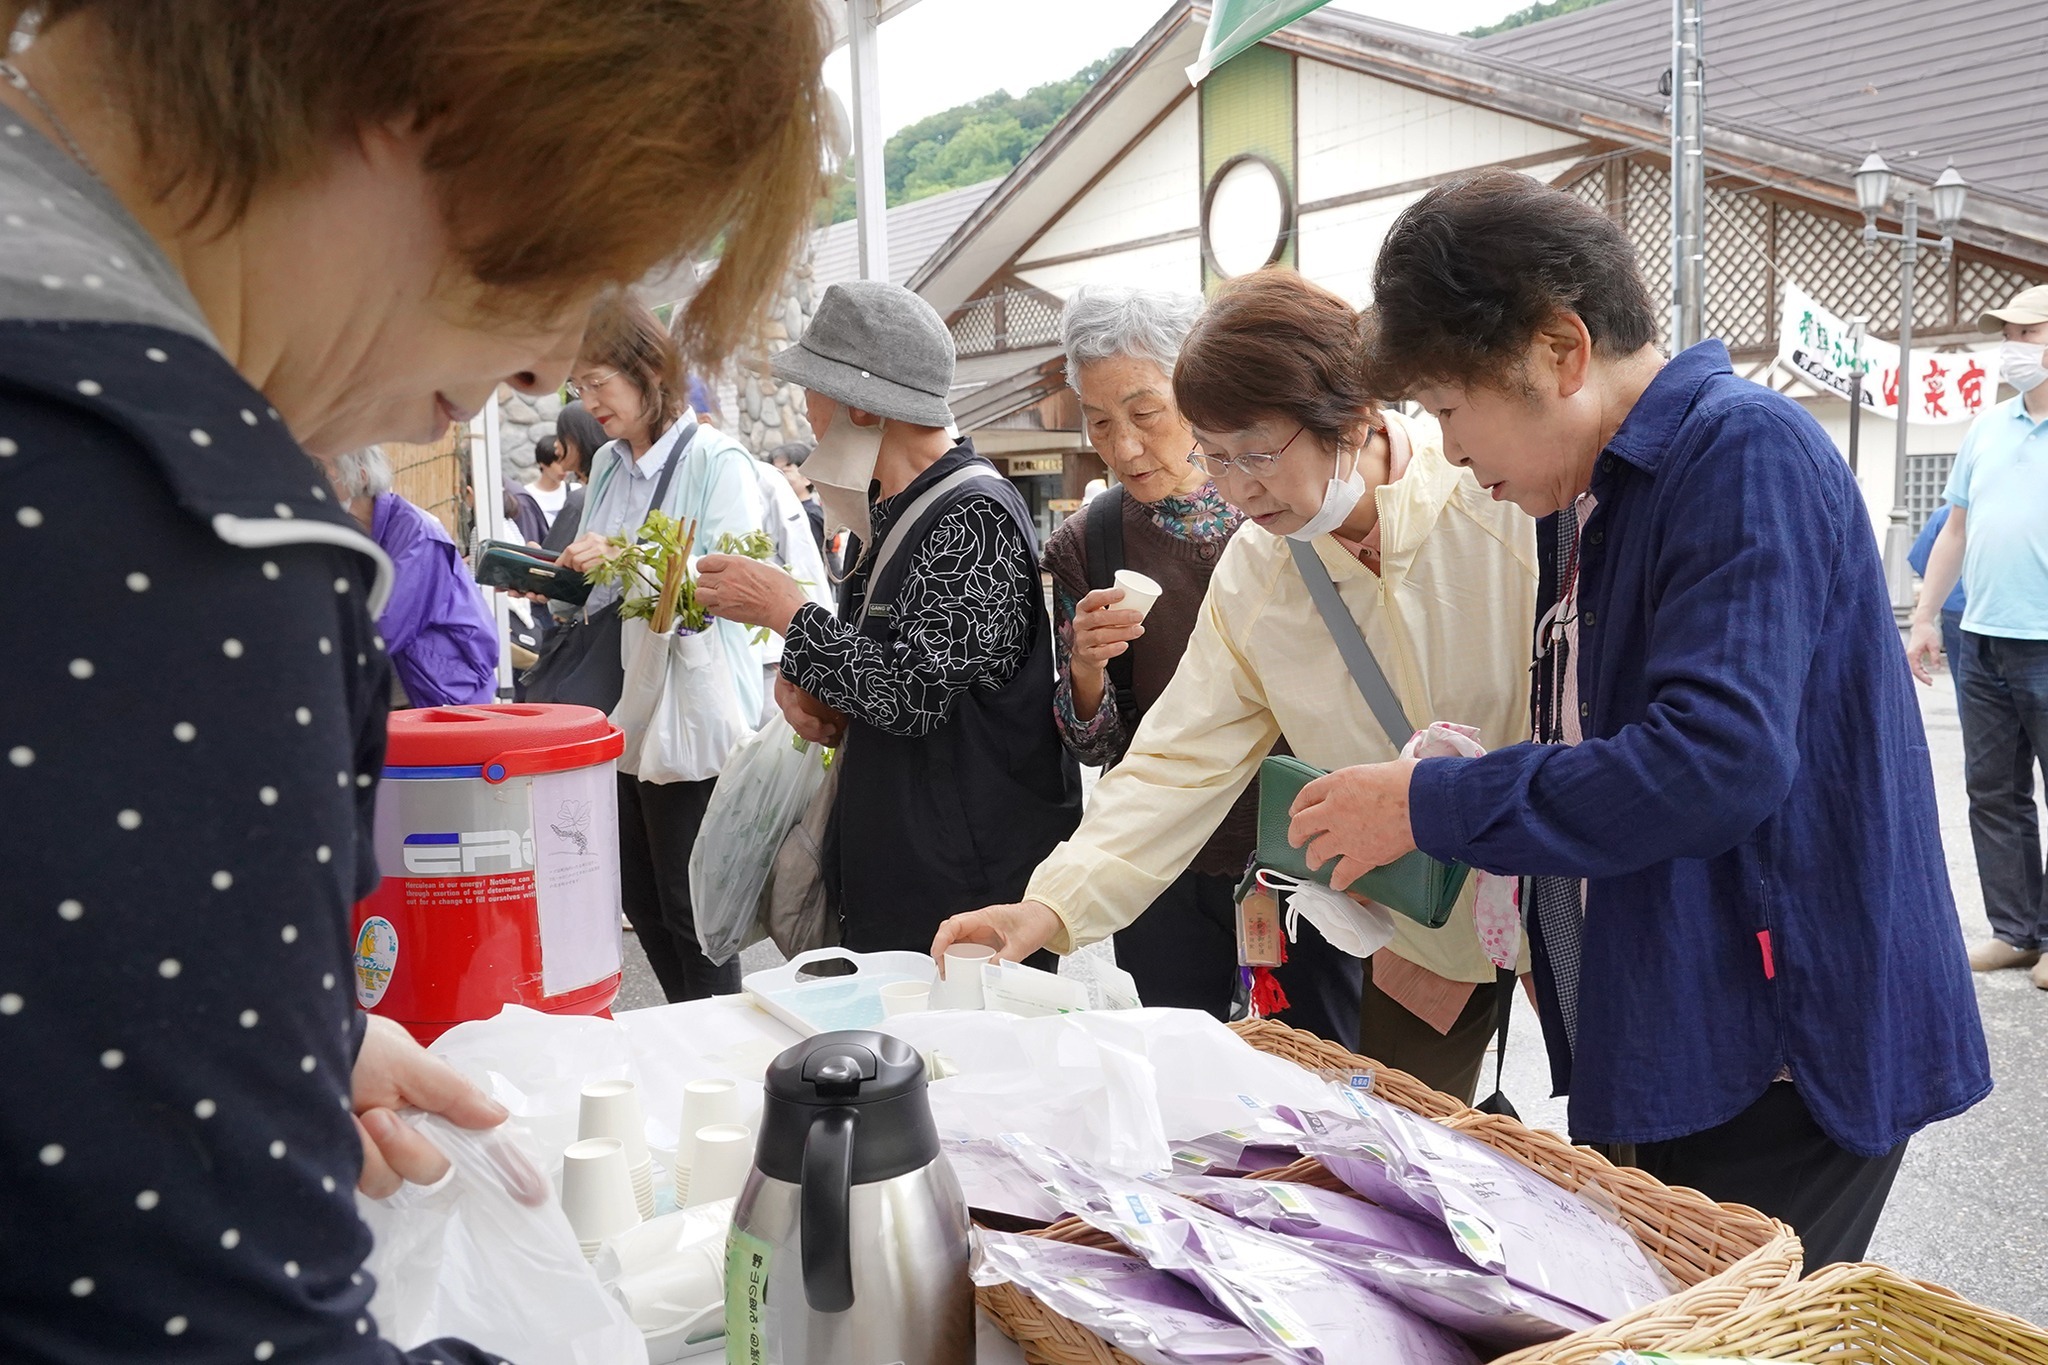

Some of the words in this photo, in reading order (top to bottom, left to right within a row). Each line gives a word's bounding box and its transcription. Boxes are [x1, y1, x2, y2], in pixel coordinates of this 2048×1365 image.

[403, 829, 534, 874] ER
[489, 878, 516, 886] Nothing
[406, 890, 430, 898] through
[433, 889, 460, 897] exertion
[487, 884, 525, 894] determined
[438, 898, 463, 906] change
[488, 894, 520, 902] ourselves
